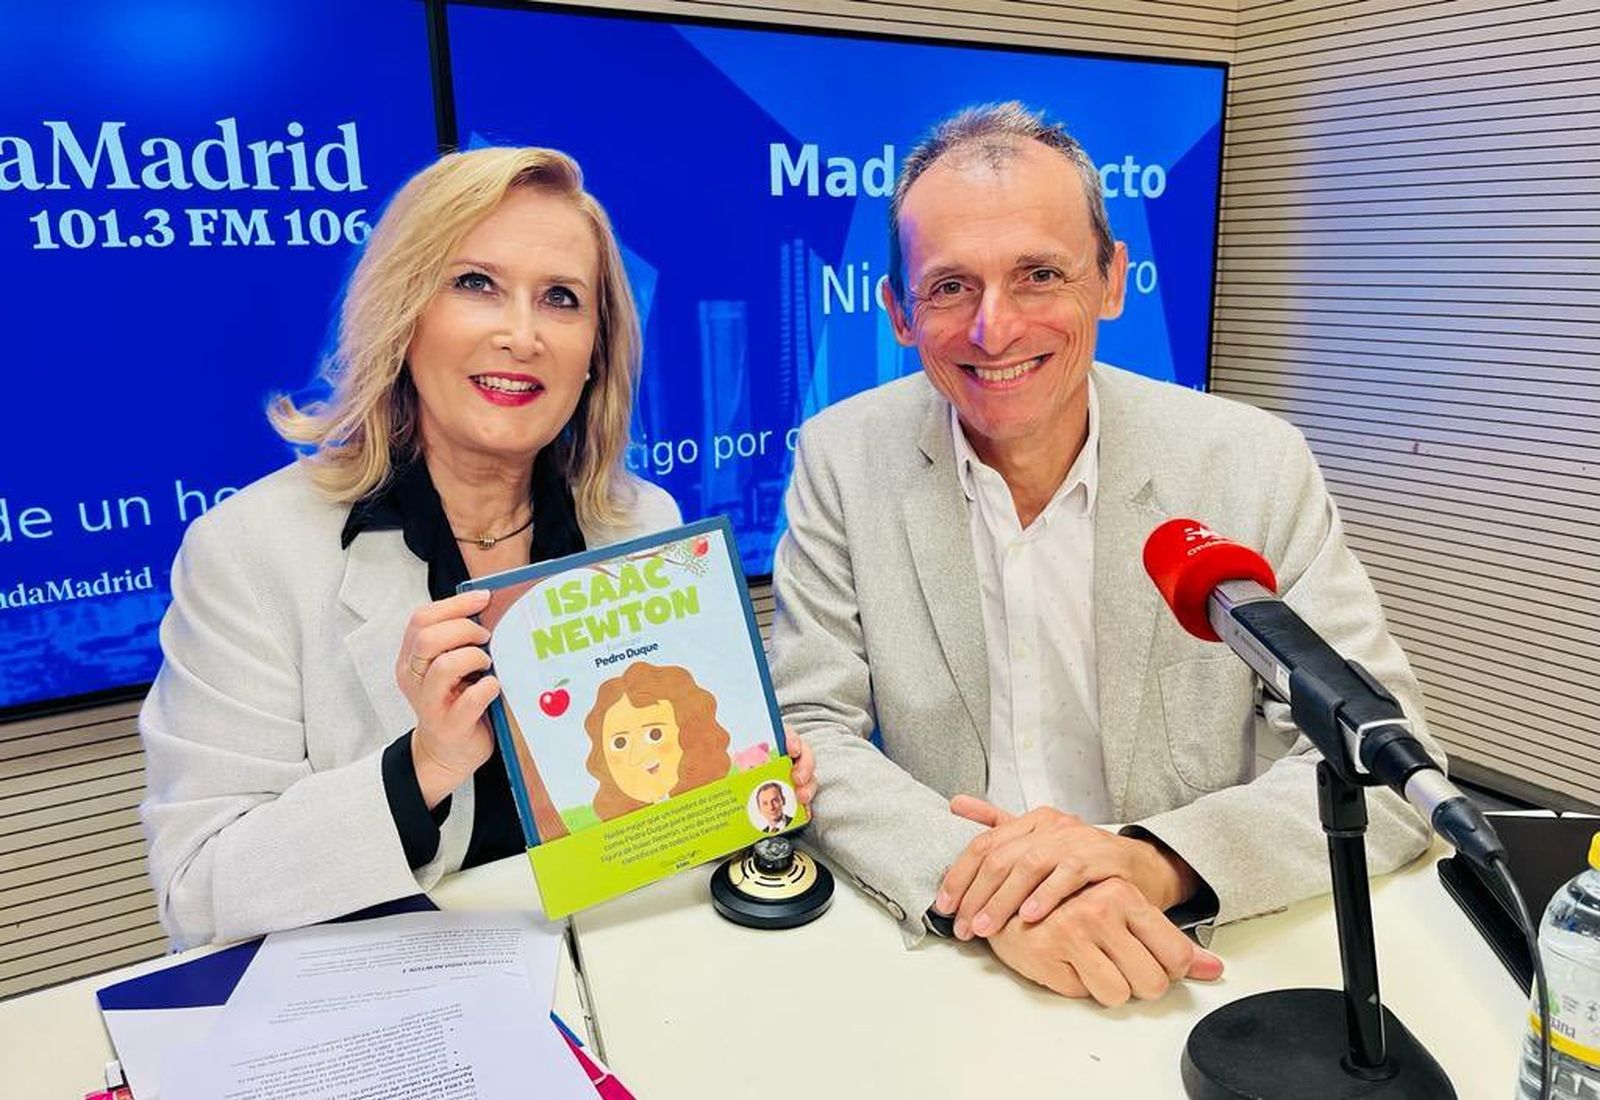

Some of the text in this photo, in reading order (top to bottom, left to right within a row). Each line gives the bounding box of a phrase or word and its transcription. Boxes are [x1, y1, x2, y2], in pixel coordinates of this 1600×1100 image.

[769, 143, 1167, 199] Mad cto
[29, 208, 175, 250] 101.3
[186, 209, 275, 247] FM
[714, 430, 773, 469] por
[79, 495, 152, 533] un
[545, 555, 671, 617] ISAAC
[531, 585, 700, 661] NEWTON
[594, 652, 626, 669] Pedro
[626, 642, 659, 659] Duque
